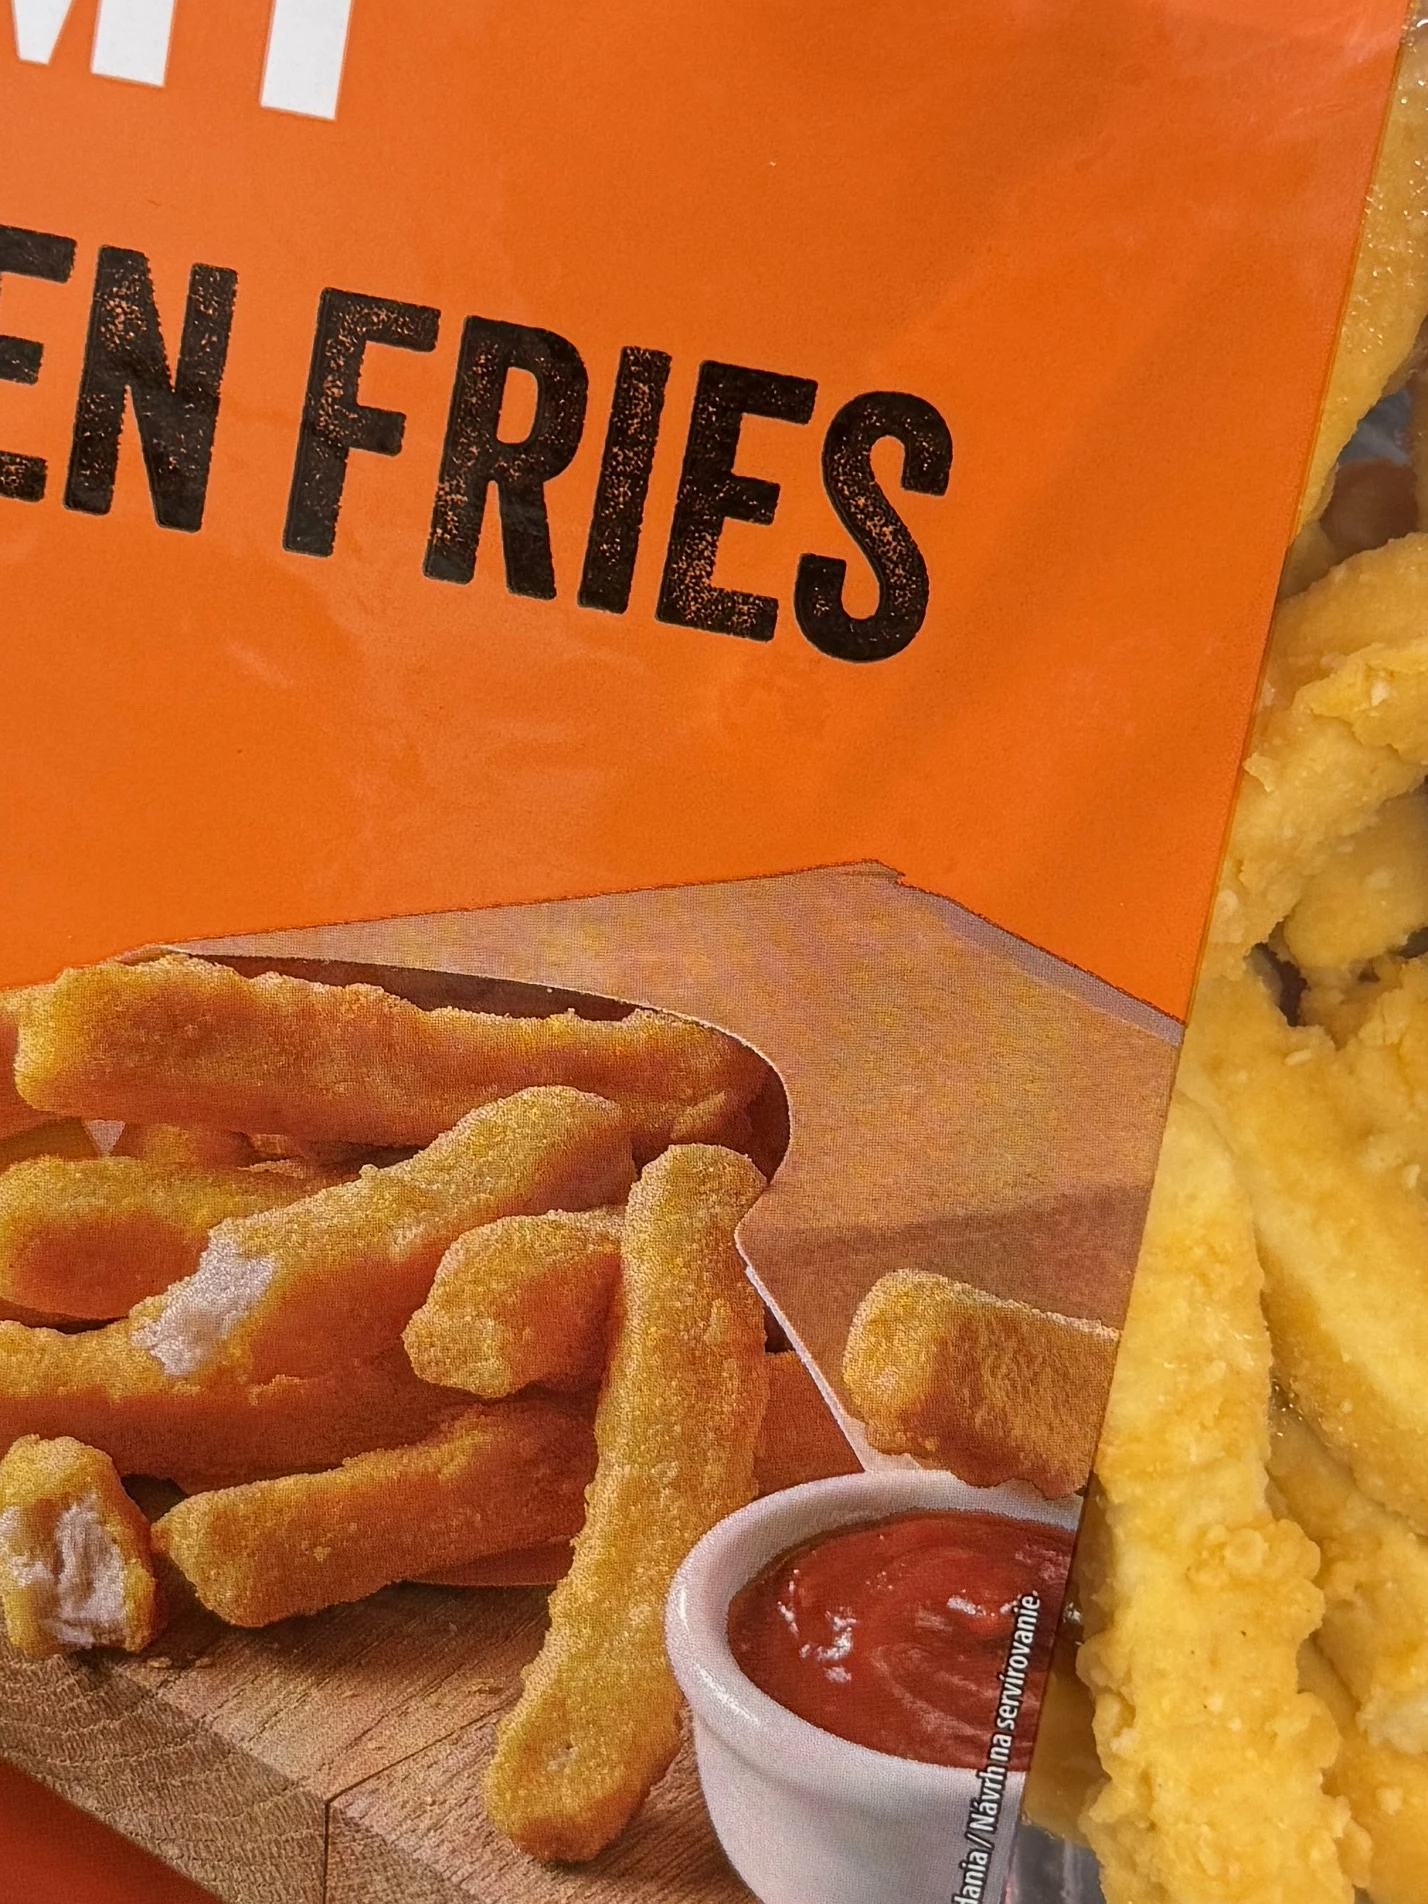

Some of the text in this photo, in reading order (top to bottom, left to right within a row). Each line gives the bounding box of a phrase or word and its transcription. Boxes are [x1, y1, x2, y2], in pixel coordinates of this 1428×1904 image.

[279, 284, 958, 665] FRIES
[968, 1764, 1006, 1832] Návrh
[990, 1733, 1013, 1763] na
